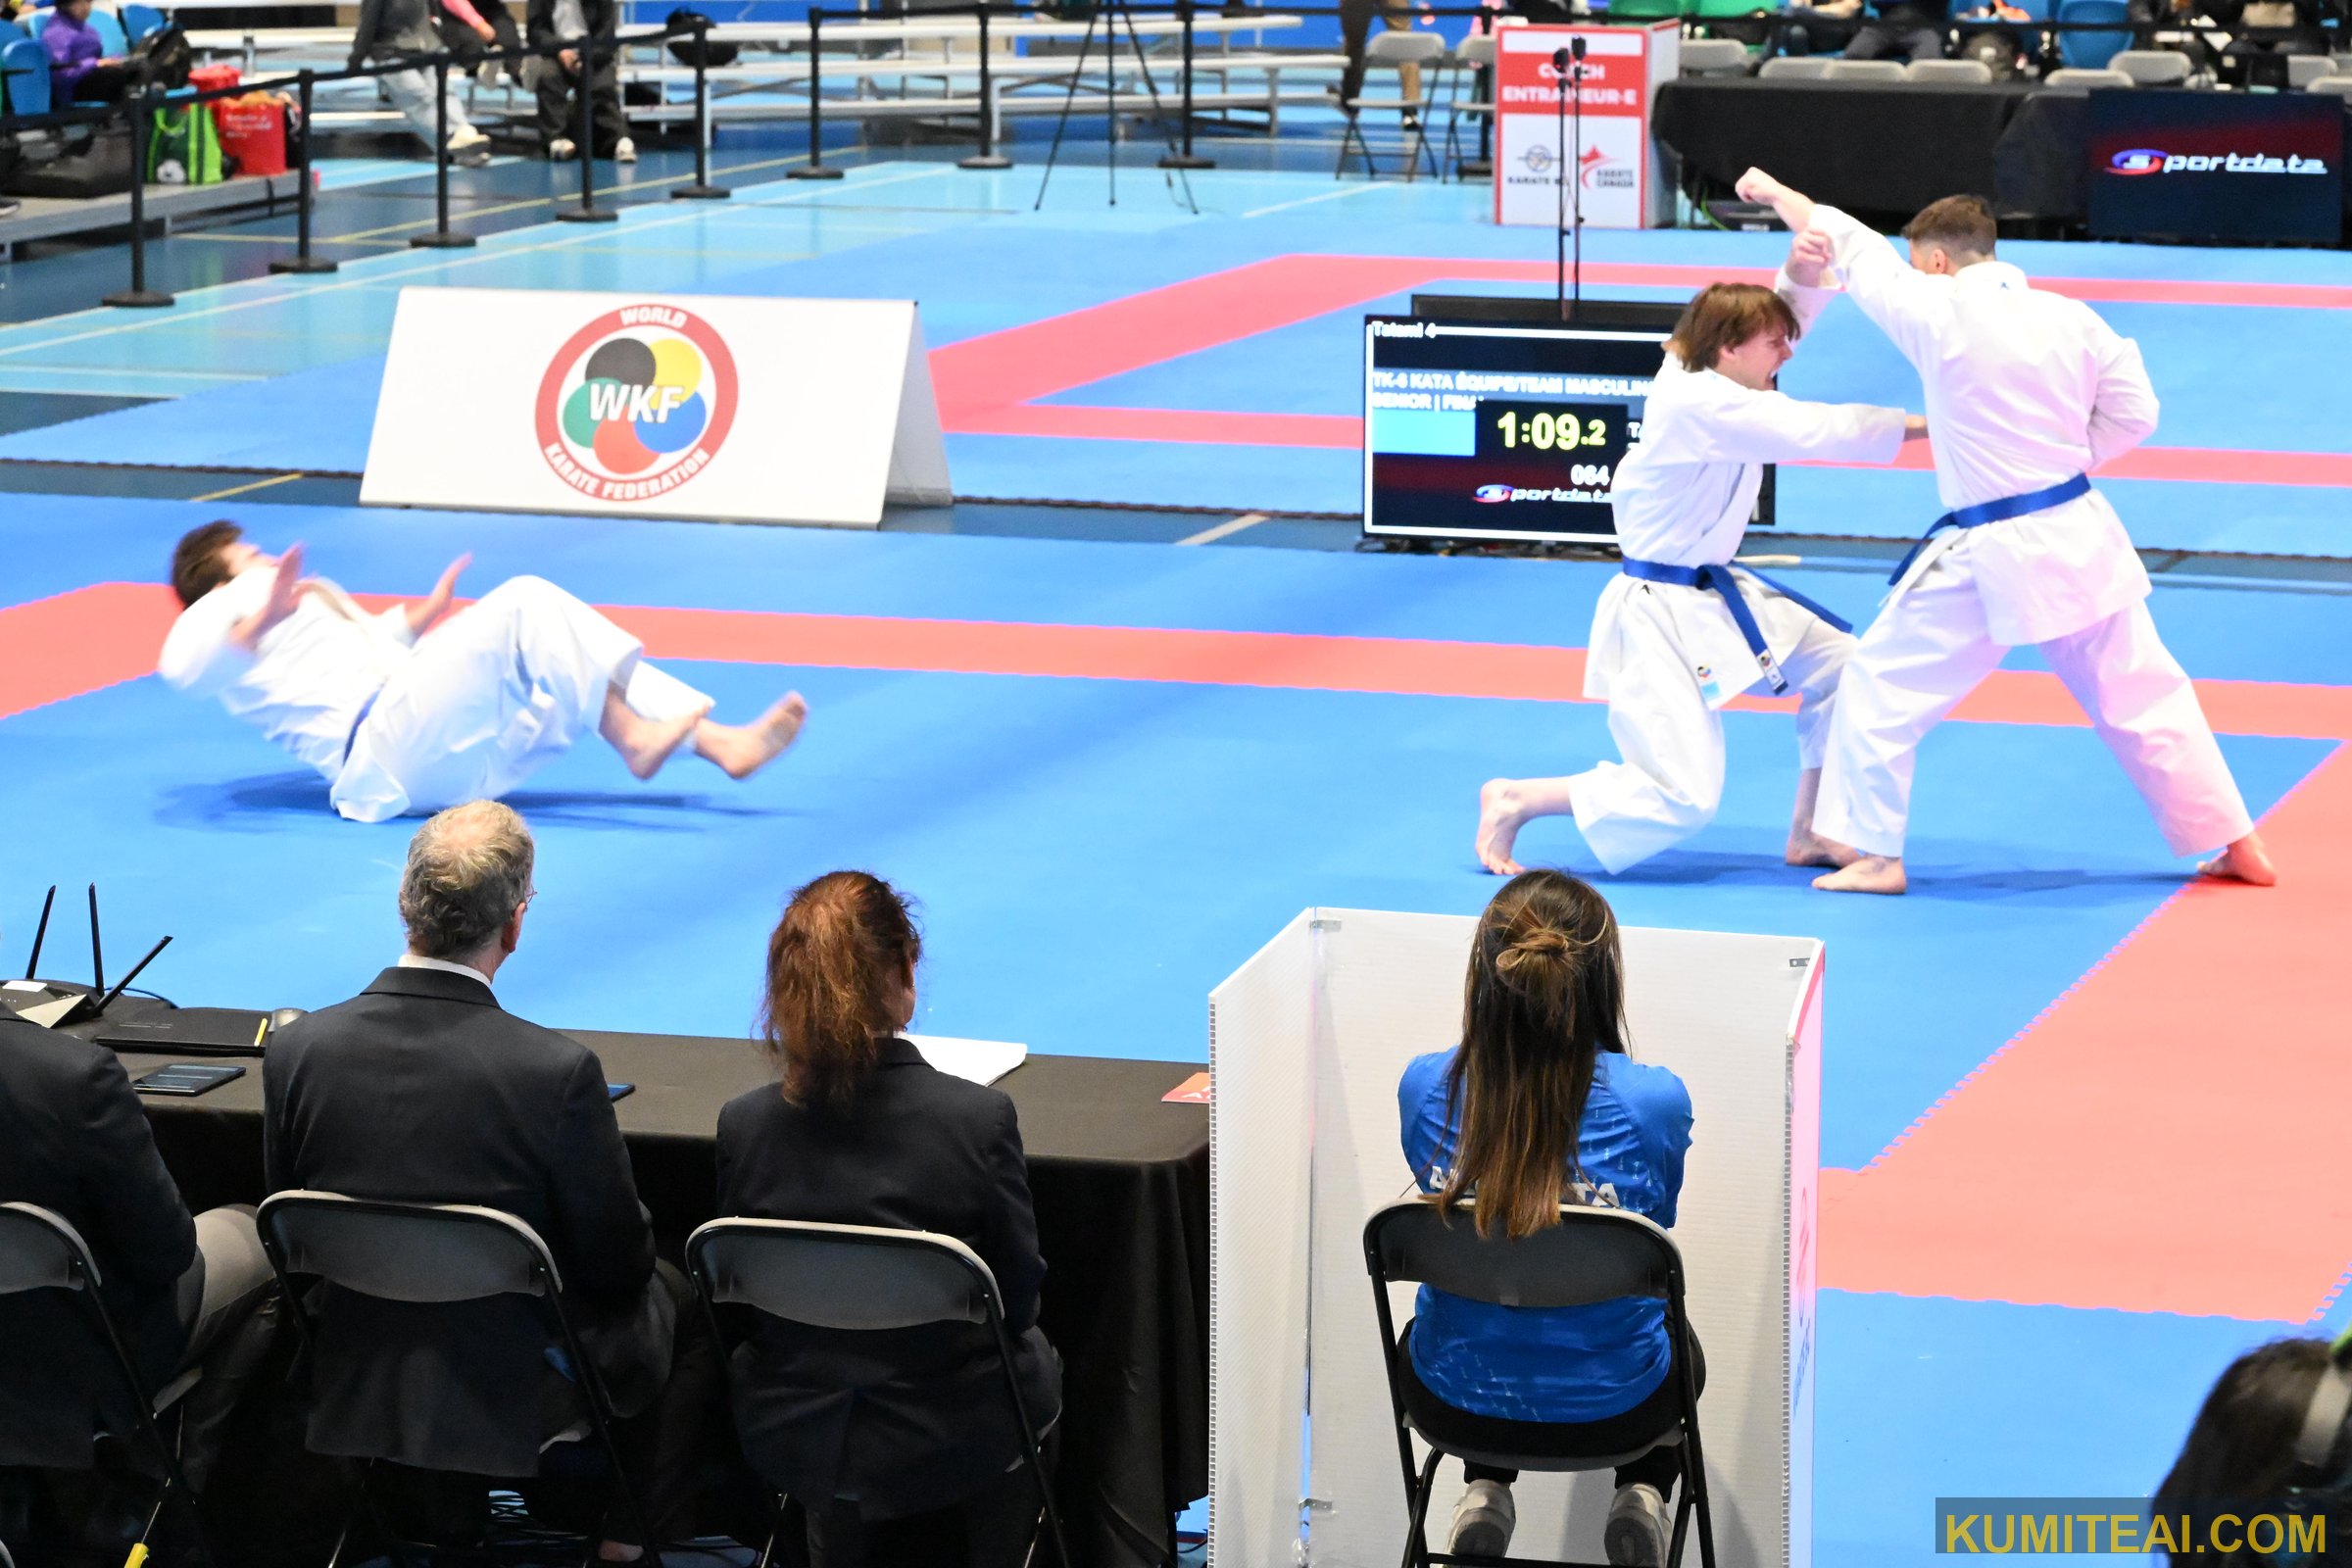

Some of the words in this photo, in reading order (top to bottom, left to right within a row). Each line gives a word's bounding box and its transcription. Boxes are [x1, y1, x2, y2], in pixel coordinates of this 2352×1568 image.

[619, 306, 687, 328] WORLD
[1410, 373, 1454, 390] KATA
[590, 382, 685, 423] WKF
[1497, 411, 1606, 451] 1:09.2
[544, 443, 600, 493] KARATE
[602, 448, 710, 500] FEDERATION
